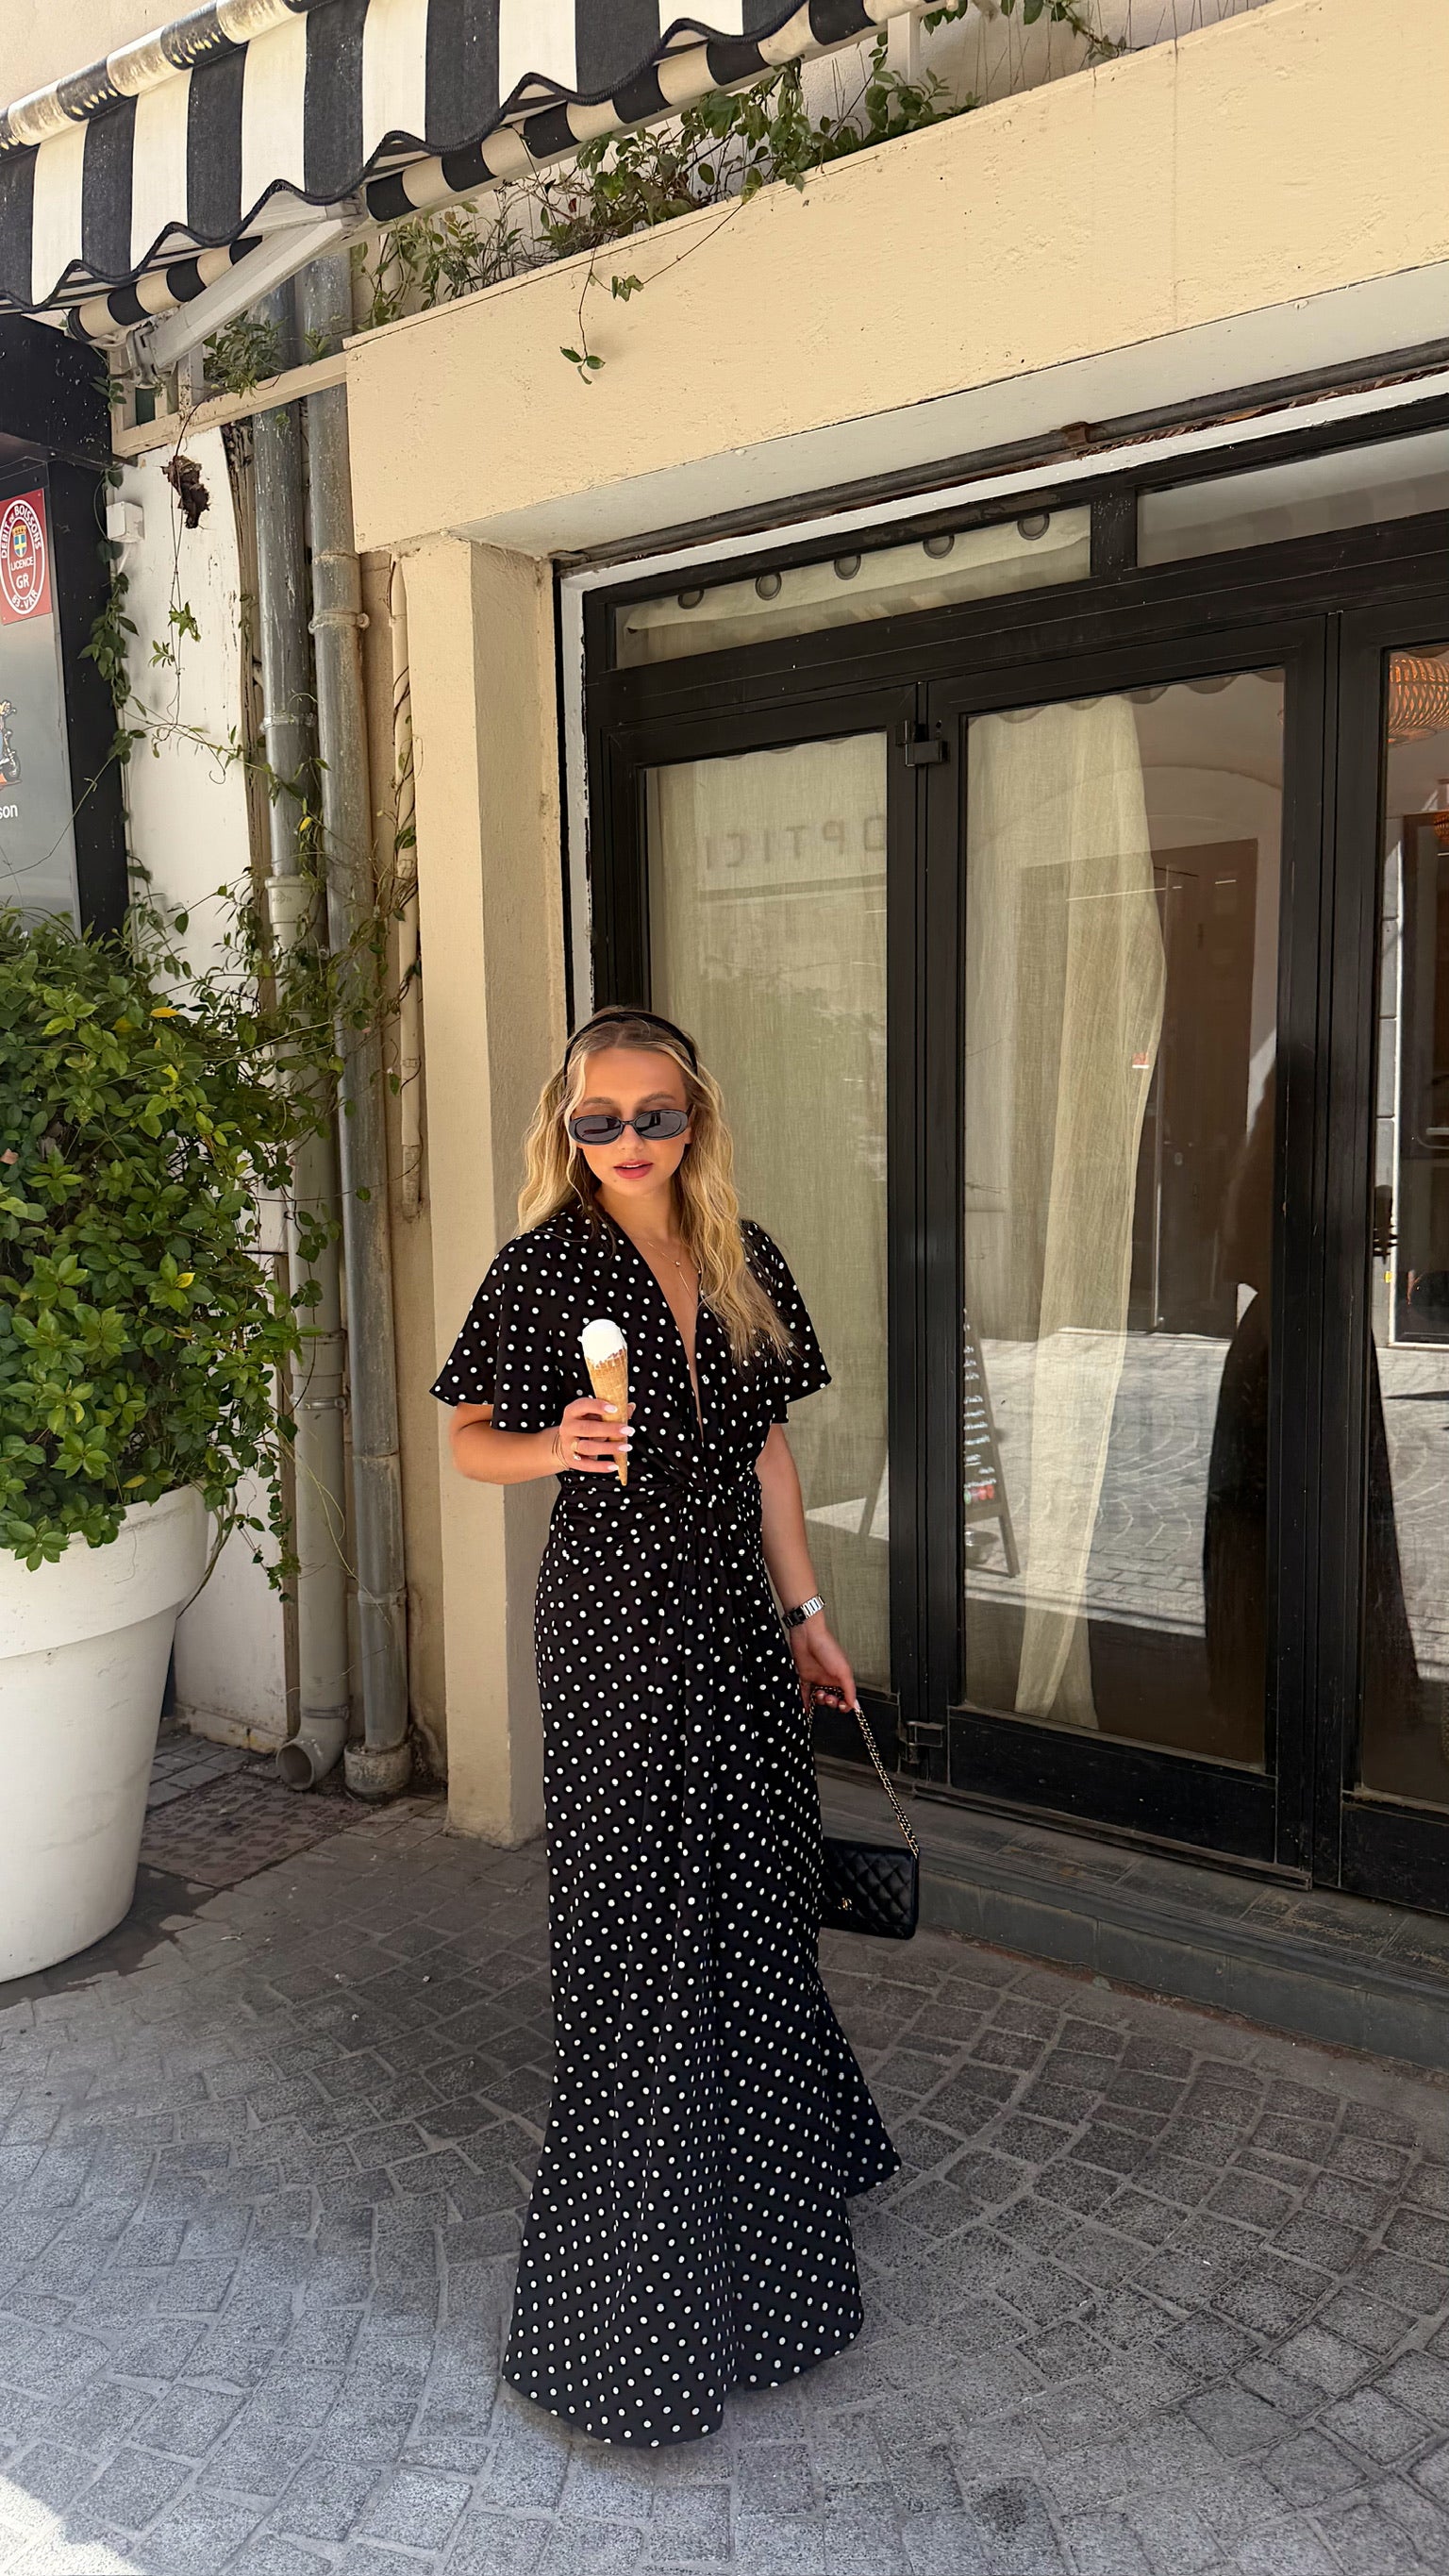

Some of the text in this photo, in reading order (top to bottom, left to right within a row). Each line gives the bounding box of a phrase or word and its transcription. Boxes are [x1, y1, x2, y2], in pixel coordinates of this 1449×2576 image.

[14, 505, 42, 550] BOISSONS
[10, 556, 34, 572] LICENCE
[16, 574, 29, 589] GR
